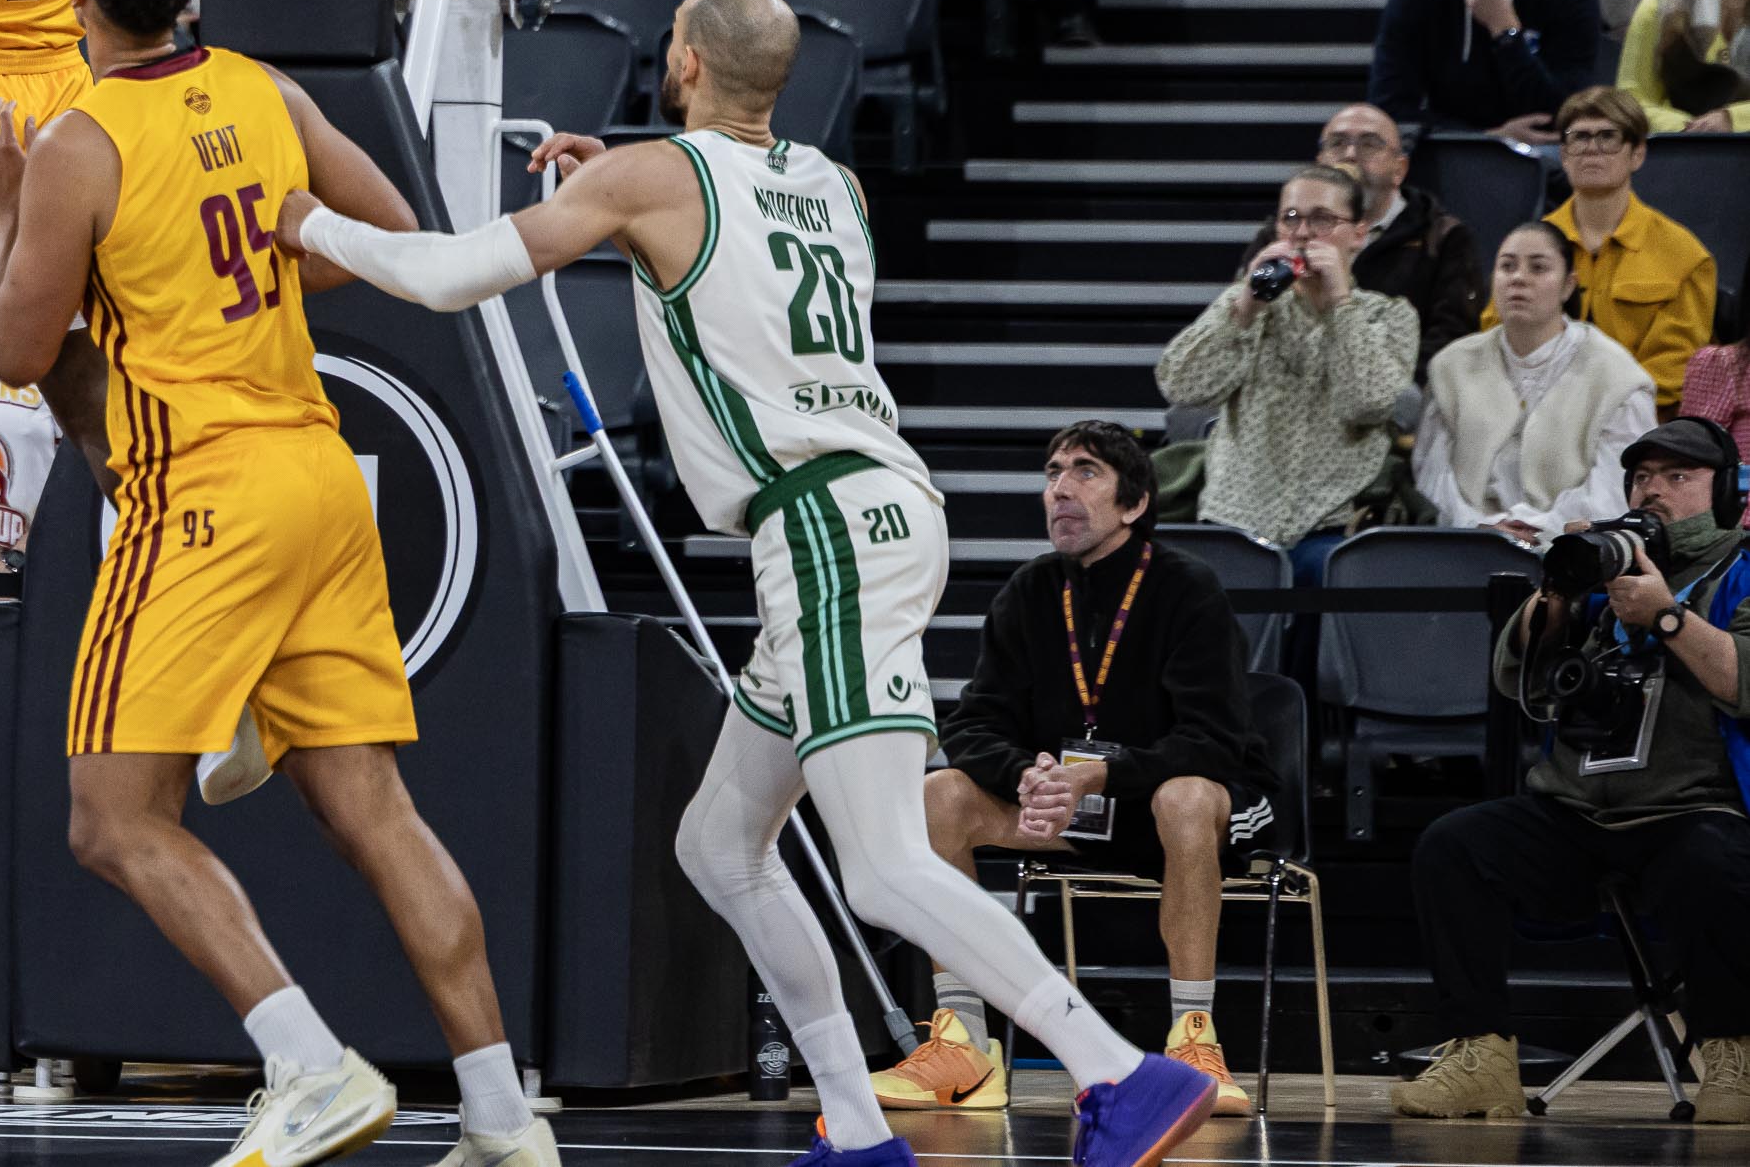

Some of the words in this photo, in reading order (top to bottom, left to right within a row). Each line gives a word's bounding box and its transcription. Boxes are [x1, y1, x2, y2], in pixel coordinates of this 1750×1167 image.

[191, 125, 243, 172] VENT
[753, 185, 833, 233] MORENCY
[200, 182, 281, 324] 95
[765, 230, 866, 364] 20
[182, 509, 215, 548] 95
[861, 502, 911, 545] 20
